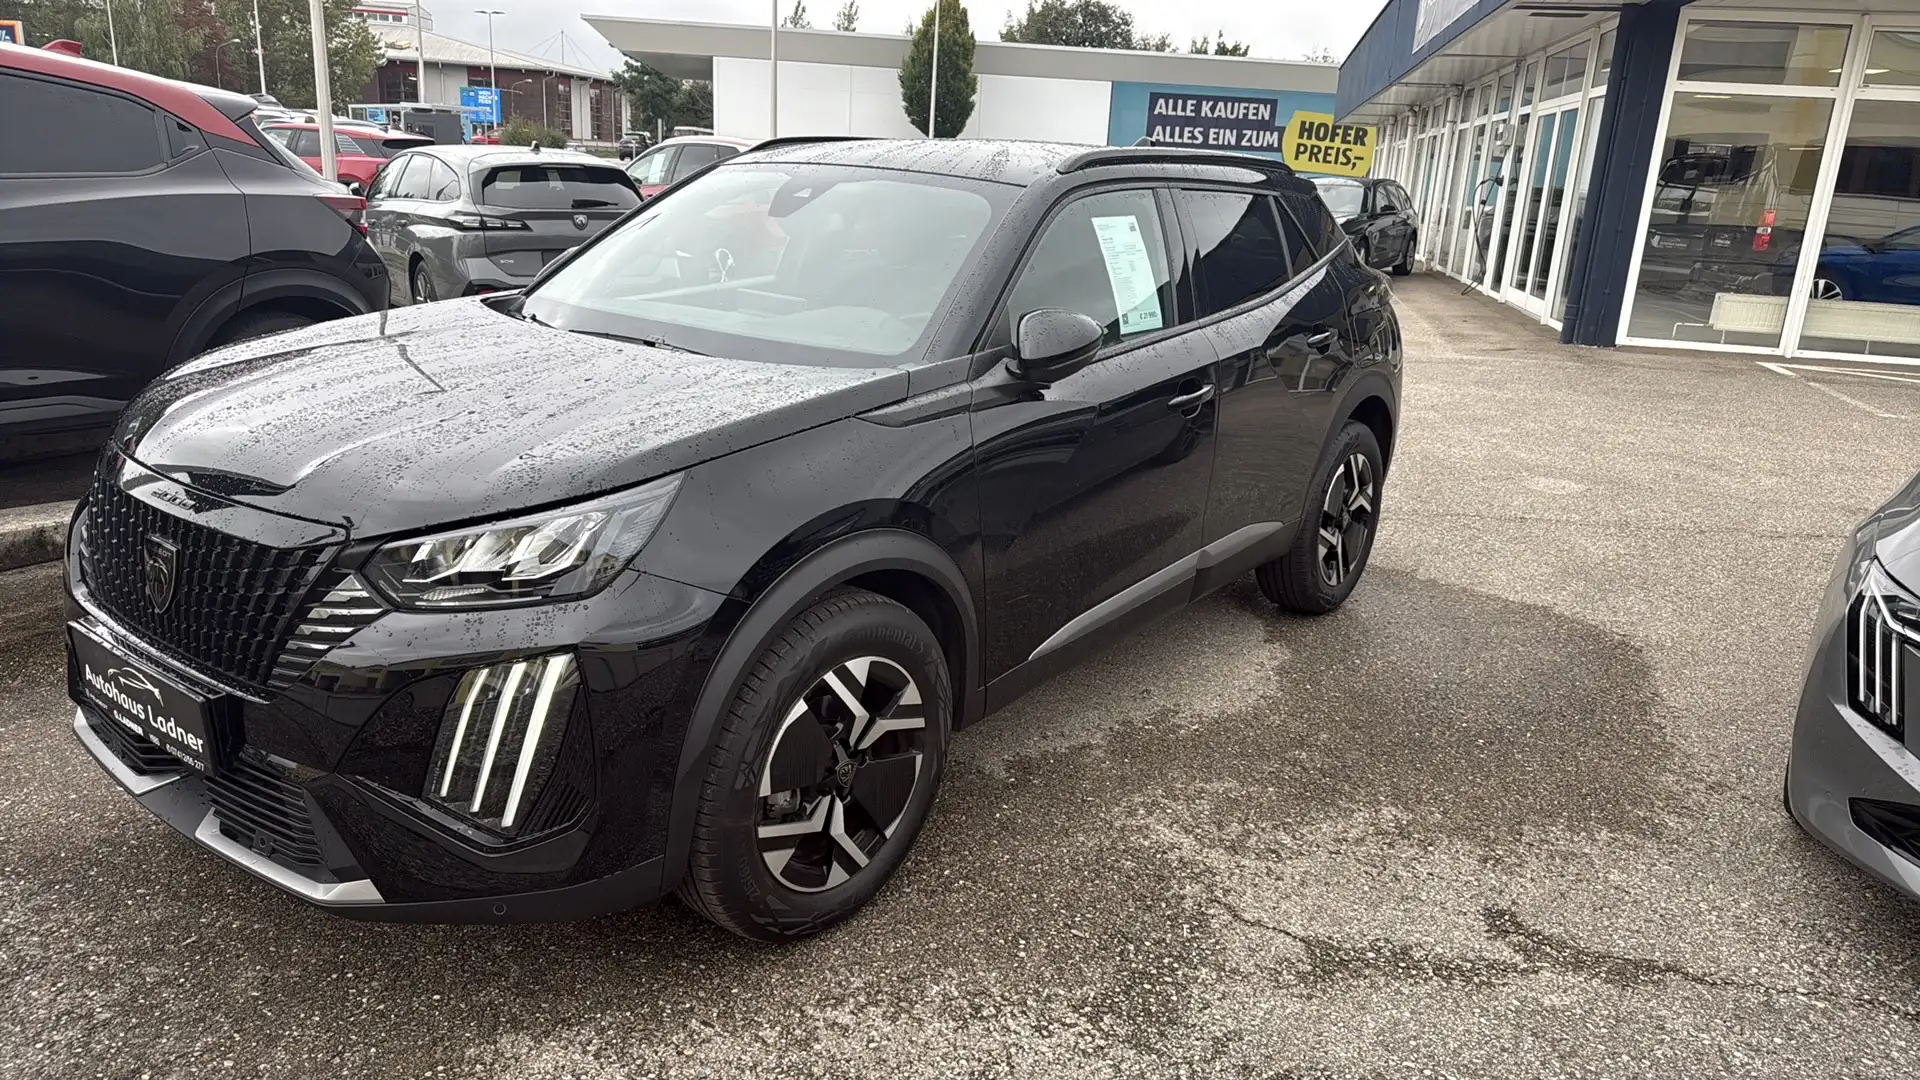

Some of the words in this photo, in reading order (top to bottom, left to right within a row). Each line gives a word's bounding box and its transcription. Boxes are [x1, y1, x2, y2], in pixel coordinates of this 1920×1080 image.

[1153, 98, 1196, 117] ALLE
[1201, 100, 1271, 120] KAUFEN
[1152, 125, 1204, 144] ALLES
[1208, 128, 1237, 145] EIN
[1240, 129, 1279, 148] ZUM
[1297, 120, 1368, 146] HOFER
[844, 627, 919, 650] ntinental
[85, 663, 146, 719] Autohaus
[148, 704, 204, 753] Ladner
